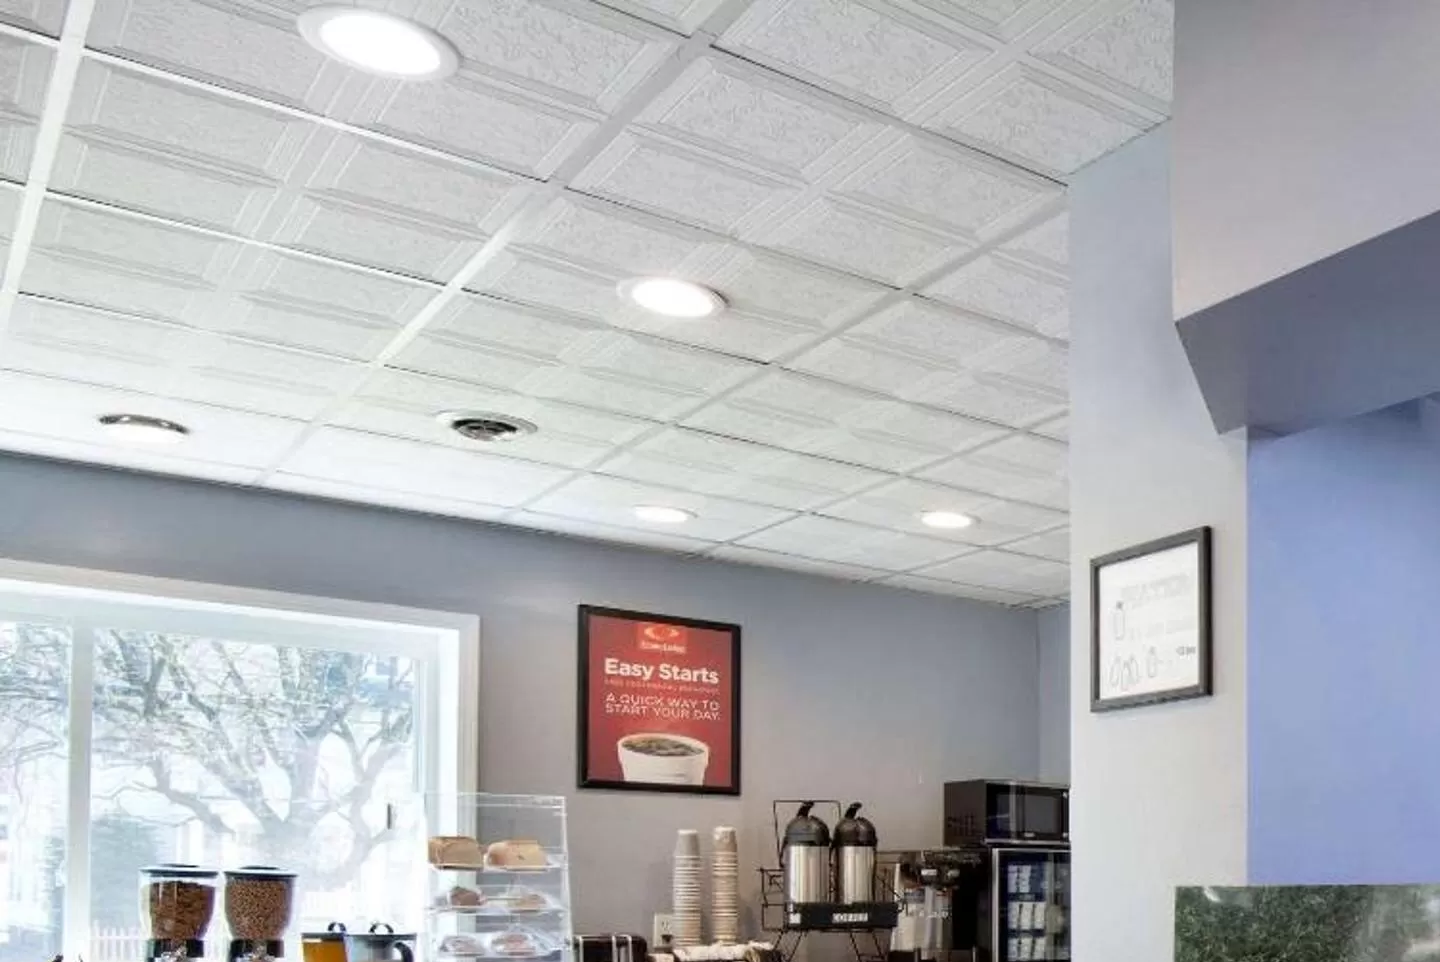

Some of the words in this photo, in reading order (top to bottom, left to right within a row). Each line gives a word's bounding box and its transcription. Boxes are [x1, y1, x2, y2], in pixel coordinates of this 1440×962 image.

[604, 657, 655, 681] Easy
[658, 663, 719, 684] Starts
[605, 692, 616, 703] A
[619, 694, 664, 707] QUICK
[668, 697, 698, 709] WAY
[702, 700, 720, 712] TO
[605, 702, 648, 716] START
[652, 707, 690, 719] YOUR
